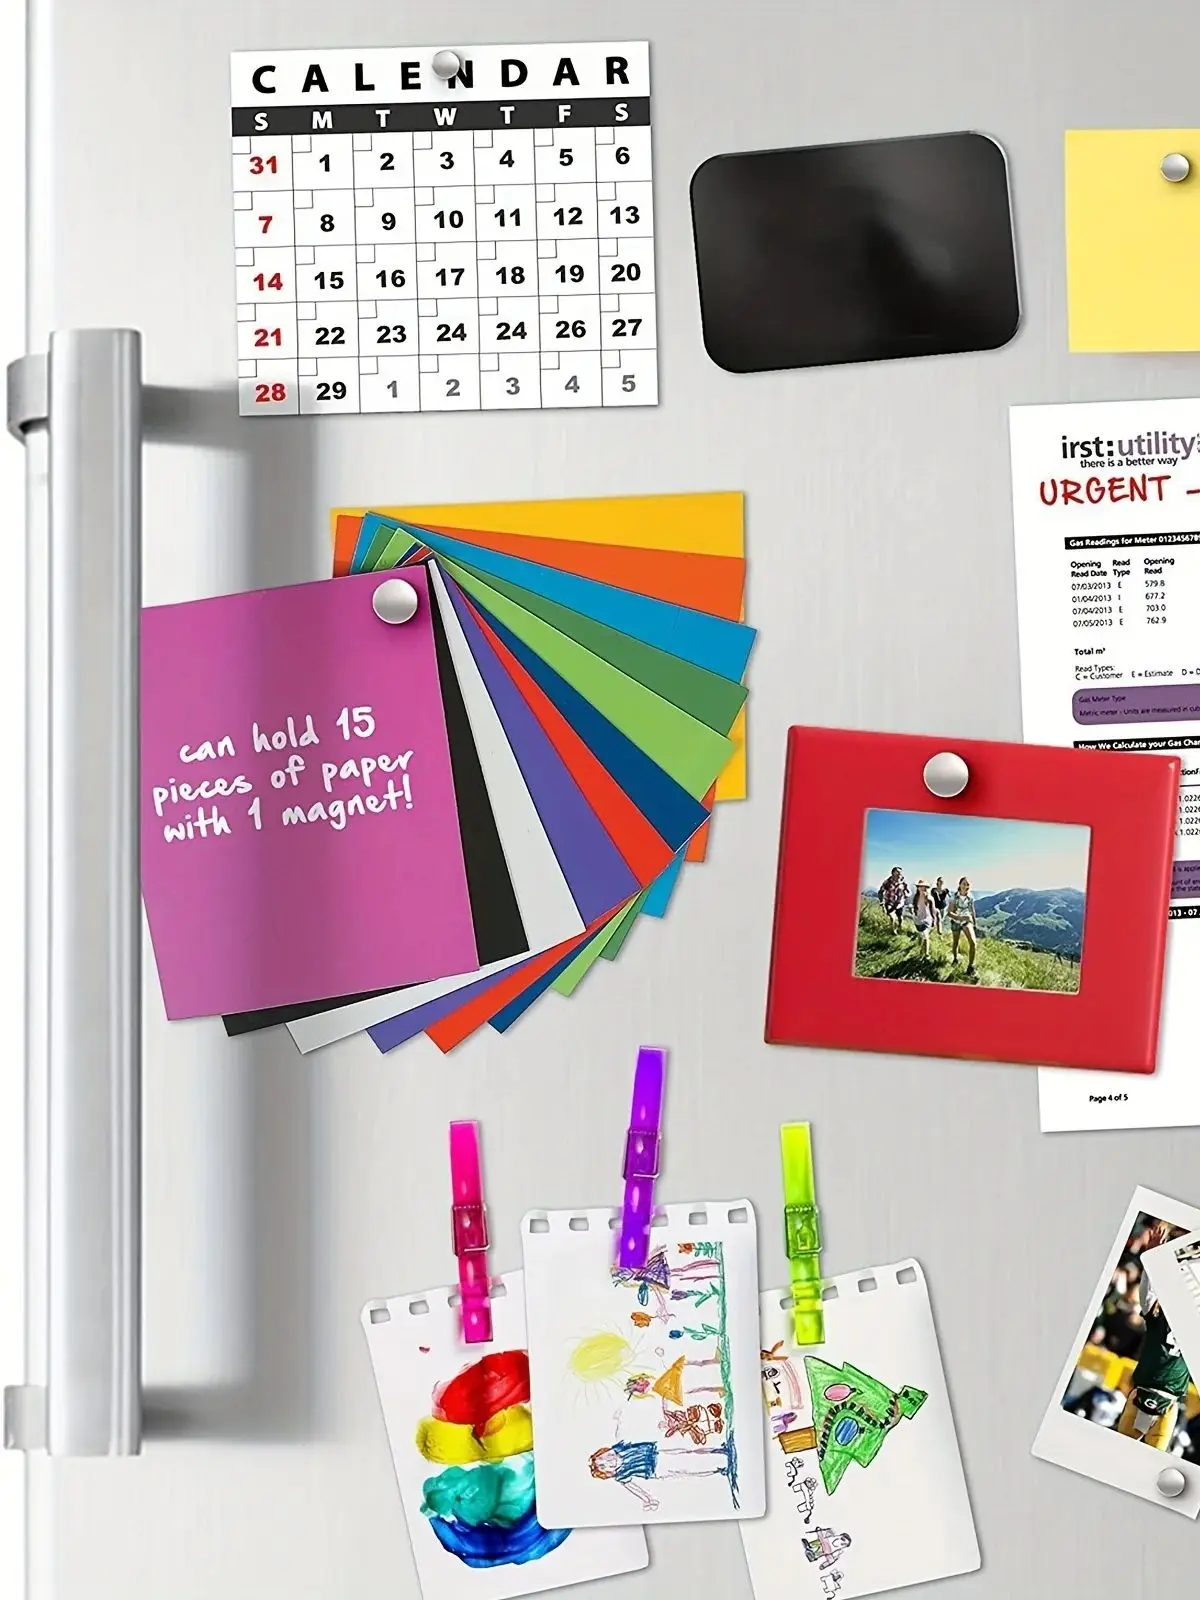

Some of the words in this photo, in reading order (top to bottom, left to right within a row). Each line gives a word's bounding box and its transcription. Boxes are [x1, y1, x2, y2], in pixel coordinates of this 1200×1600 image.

[252, 56, 630, 95] CALENDAR
[254, 112, 269, 131] S
[312, 110, 333, 129] M
[376, 109, 391, 128] T
[434, 107, 457, 126] W
[500, 105, 515, 124] T
[558, 104, 571, 123] F
[615, 103, 629, 122] S
[249, 156, 278, 175] 31
[318, 153, 332, 173] 1
[379, 152, 395, 171] 2
[439, 151, 455, 170] 3
[499, 149, 515, 168] 4
[559, 148, 574, 167] 5
[615, 146, 631, 165] 6
[258, 215, 273, 234] 7
[320, 213, 336, 233] 8
[381, 212, 397, 231] 9
[433, 210, 464, 229] 10
[494, 208, 522, 228] 11
[553, 206, 584, 226] 12
[609, 205, 641, 225] 13
[253, 272, 284, 292] 14
[314, 271, 345, 290] 15
[375, 269, 406, 288] 16
[435, 267, 465, 287] 17
[495, 265, 526, 285] 18
[554, 264, 585, 283] 19
[610, 262, 642, 282] 20
[254, 327, 282, 347] 21
[314, 326, 346, 346] 22
[376, 325, 407, 344] 23
[436, 322, 468, 343] 24
[495, 321, 528, 341] 24
[555, 319, 587, 339] 26
[611, 318, 643, 338] 27
[255, 382, 287, 403] 28
[316, 381, 347, 401] 29
[386, 380, 398, 399] 1
[445, 378, 461, 397] 2
[505, 377, 521, 396] 3
[564, 375, 580, 394] 4
[622, 374, 636, 393] 5
[1080, 458, 1106, 468] there
[1107, 457, 1116, 467] is
[1117, 458, 1124, 466] a
[1125, 455, 1155, 467] better
[1157, 456, 1178, 467] way
[1039, 473, 1171, 506] URGENT
[1069, 538, 1084, 547] Gas
[1085, 537, 1120, 547] Readings
[1121, 536, 1133, 544] for
[1134, 536, 1157, 545] Meter
[1070, 560, 1102, 569] Opening
[1112, 559, 1131, 567] Read
[1143, 557, 1175, 566] Opening
[1071, 570, 1089, 578] Read
[1090, 569, 1108, 577] Date
[1112, 568, 1131, 577] Type
[1144, 567, 1163, 575] Read
[1071, 581, 1112, 591] 07/03/2013
[1144, 579, 1166, 588] 579.8
[1071, 594, 1112, 603] 01/04/2013
[1145, 591, 1166, 600] 677.2
[1072, 606, 1113, 616] 07/04/2013
[1118, 605, 1124, 613] E
[1146, 603, 1167, 612] 703.0
[1072, 618, 1113, 628] 07/05/2013
[1119, 618, 1124, 626] E
[1146, 616, 1167, 625] 762.9
[1074, 647, 1094, 656] Total
[1074, 665, 1093, 673] Read
[1075, 672, 1081, 681] C
[1089, 671, 1123, 681] Customer
[1131, 670, 1136, 678] E
[1144, 669, 1174, 678] Estimate
[1181, 668, 1188, 676] D
[178, 735, 236, 764] can
[252, 714, 320, 753] hold
[335, 705, 376, 741] 15
[1097, 742, 1111, 750] We
[1112, 740, 1147, 749] Calculate
[1148, 740, 1166, 750] your
[1167, 739, 1182, 747] Gas
[152, 777, 253, 817] pieces
[270, 754, 306, 789] of
[321, 750, 414, 793] paper
[163, 804, 232, 843] with
[247, 796, 262, 830] 1
[281, 773, 414, 831] magnet!
[1089, 1095, 1107, 1104] Page
[1113, 1093, 1122, 1101] of
[1123, 1093, 1129, 1101] 5
